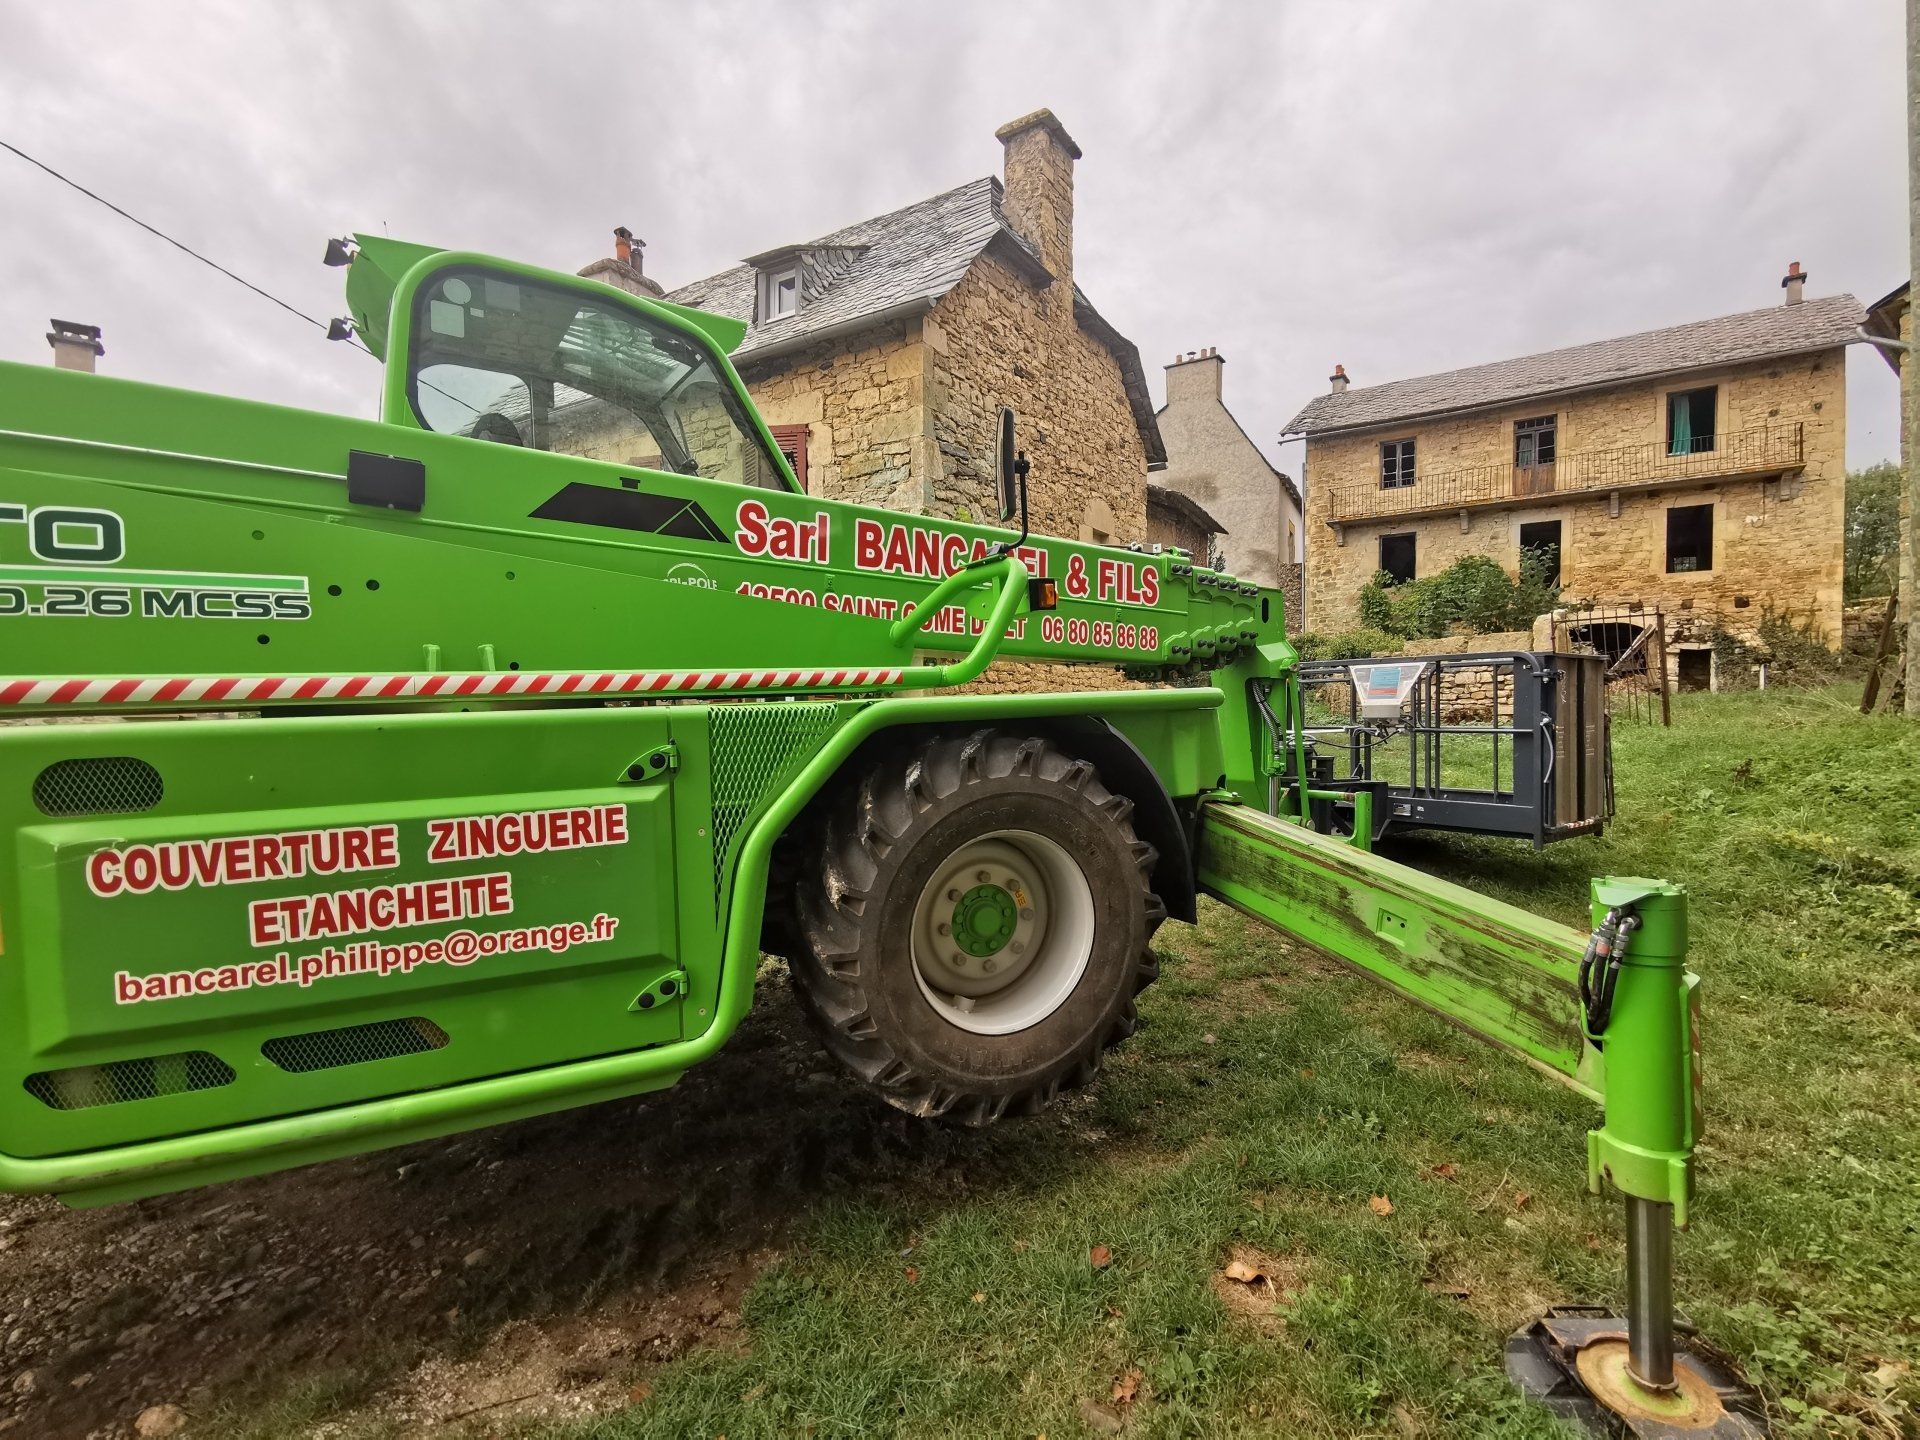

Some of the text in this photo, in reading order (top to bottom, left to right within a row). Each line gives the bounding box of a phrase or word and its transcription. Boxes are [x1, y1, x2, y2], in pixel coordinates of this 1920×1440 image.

[0, 503, 125, 564] O
[736, 500, 830, 565] Sarl
[1065, 553, 1091, 598] &
[1098, 558, 1160, 606] FILS
[142, 590, 311, 619] MCSS
[822, 592, 898, 621] SAINT
[1041, 616, 1064, 643] 06
[1067, 618, 1089, 645] 80
[1092, 621, 1113, 647] 85
[1116, 623, 1136, 650] 86
[1138, 626, 1159, 650] 88
[86, 804, 629, 897] COUVERTURE ZINGUERIE
[248, 871, 513, 947] ETANCHEITE
[114, 913, 620, 1005] bancarel.philippe@orange.fr
